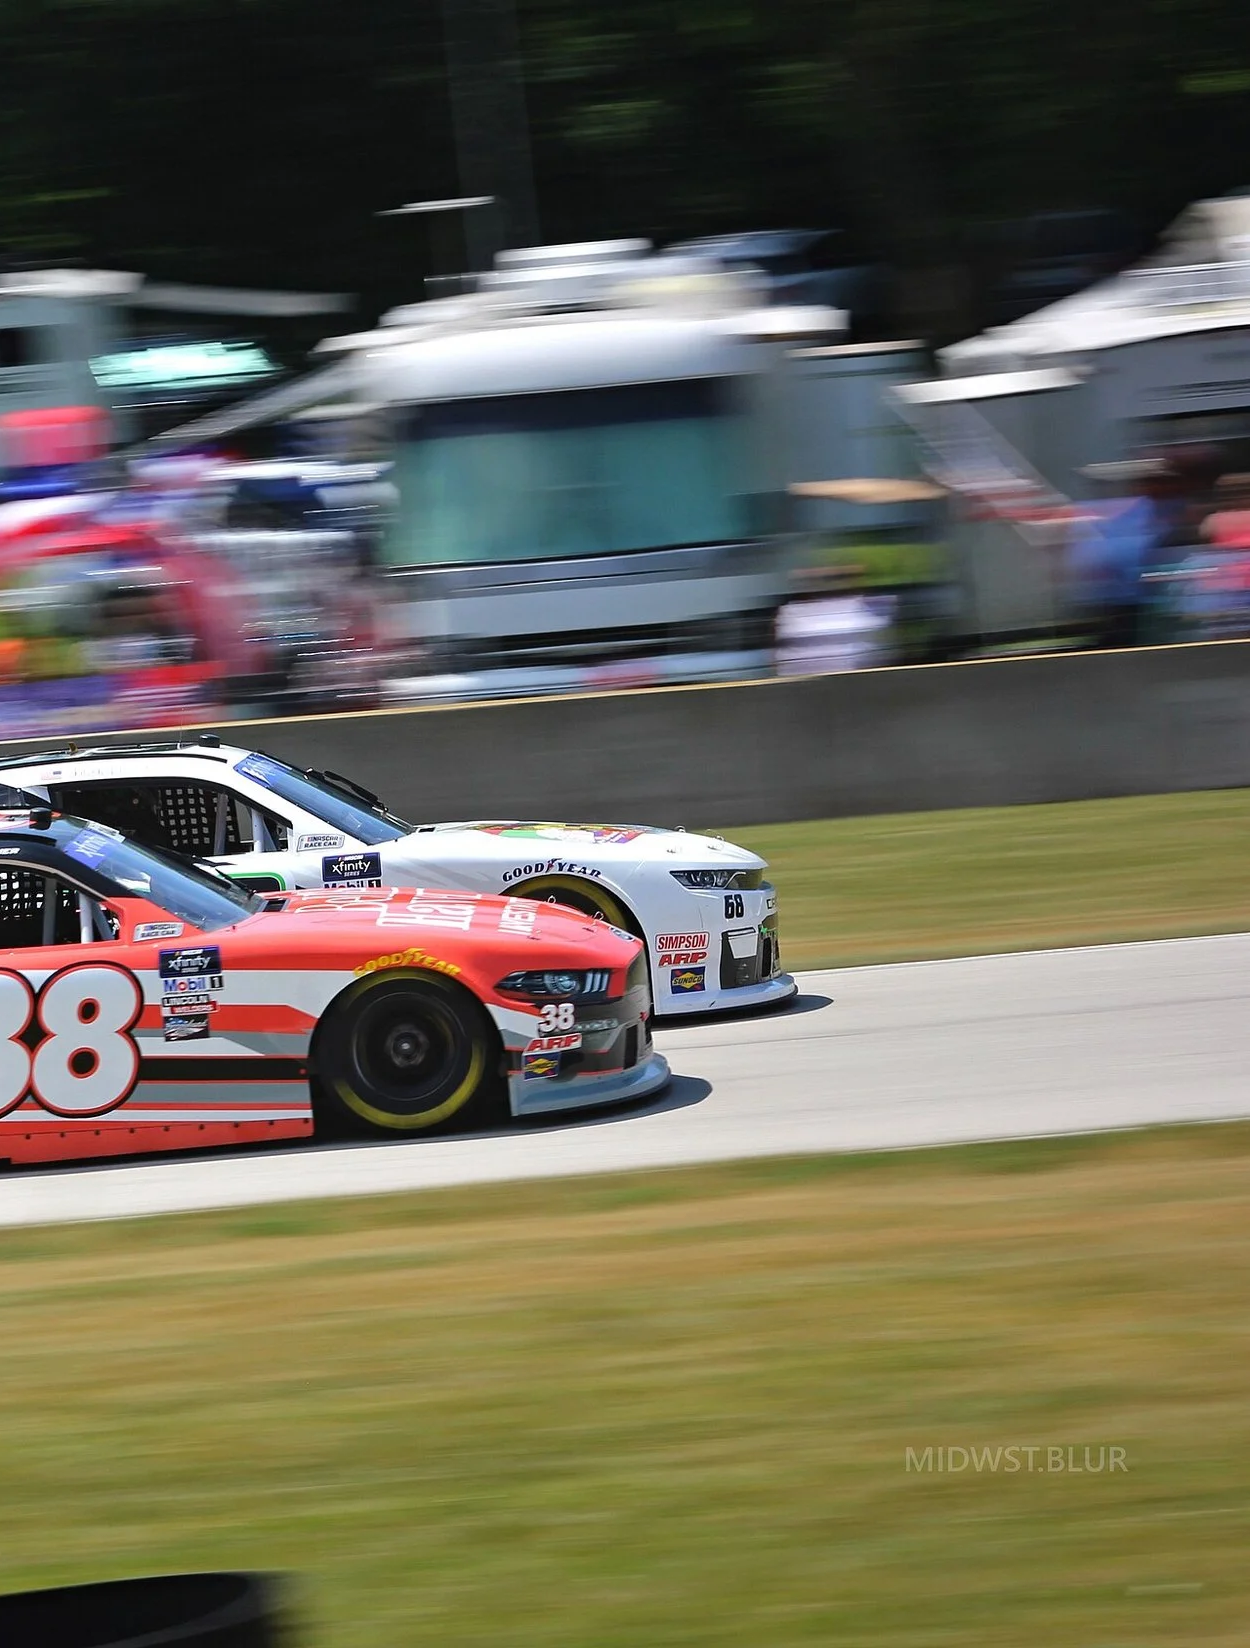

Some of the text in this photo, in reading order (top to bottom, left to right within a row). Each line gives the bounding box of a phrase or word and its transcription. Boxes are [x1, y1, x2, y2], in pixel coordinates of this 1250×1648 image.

[332, 861, 371, 875] xfinity
[724, 894, 745, 919] 68
[658, 934, 707, 950] SIMPSON
[658, 951, 707, 967] ARP
[163, 977, 206, 992] Mobil
[673, 975, 703, 985] SUNOCO
[163, 995, 208, 1006] LINCOLN
[538, 1002, 575, 1033] 38
[528, 1034, 580, 1051] ARP
